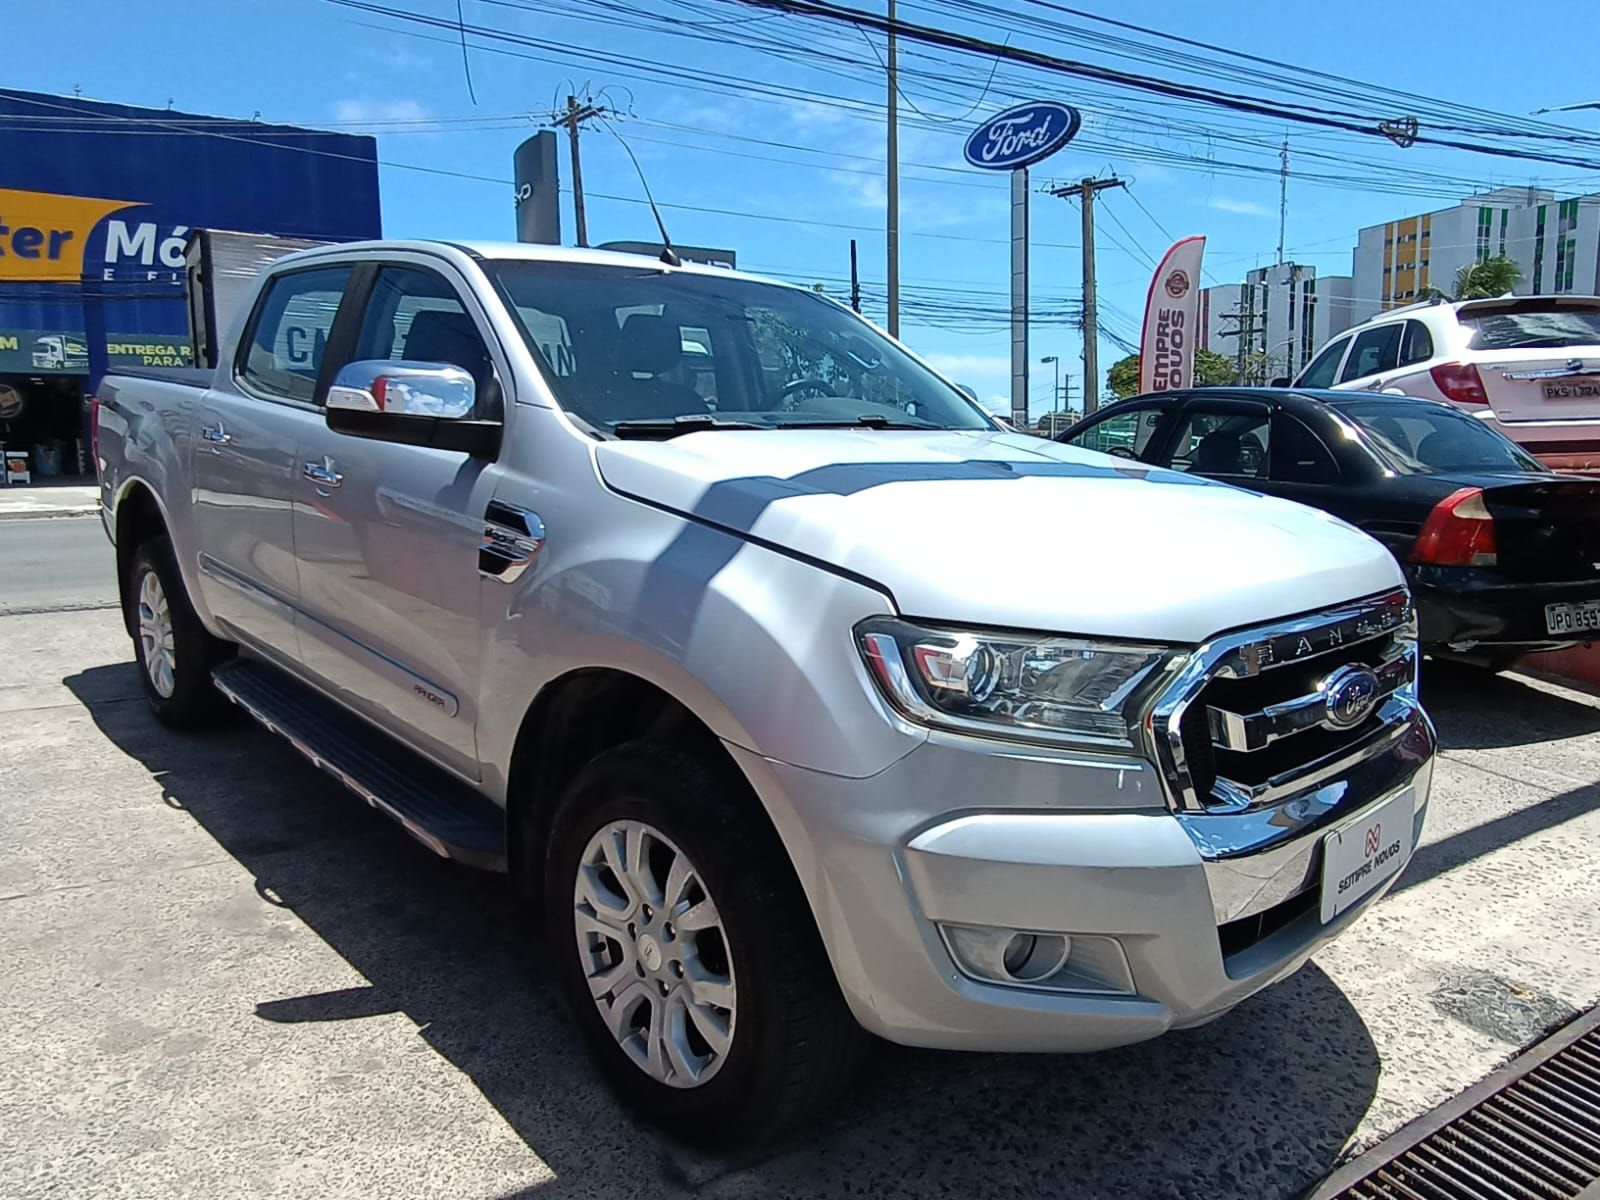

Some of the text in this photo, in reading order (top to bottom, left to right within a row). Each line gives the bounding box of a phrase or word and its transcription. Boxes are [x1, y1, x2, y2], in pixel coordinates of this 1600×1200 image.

[982, 112, 1052, 161] Ford
[107, 343, 176, 356] ENTREGA
[143, 356, 184, 367] PARA
[1338, 859, 1372, 895] SEMPRE
